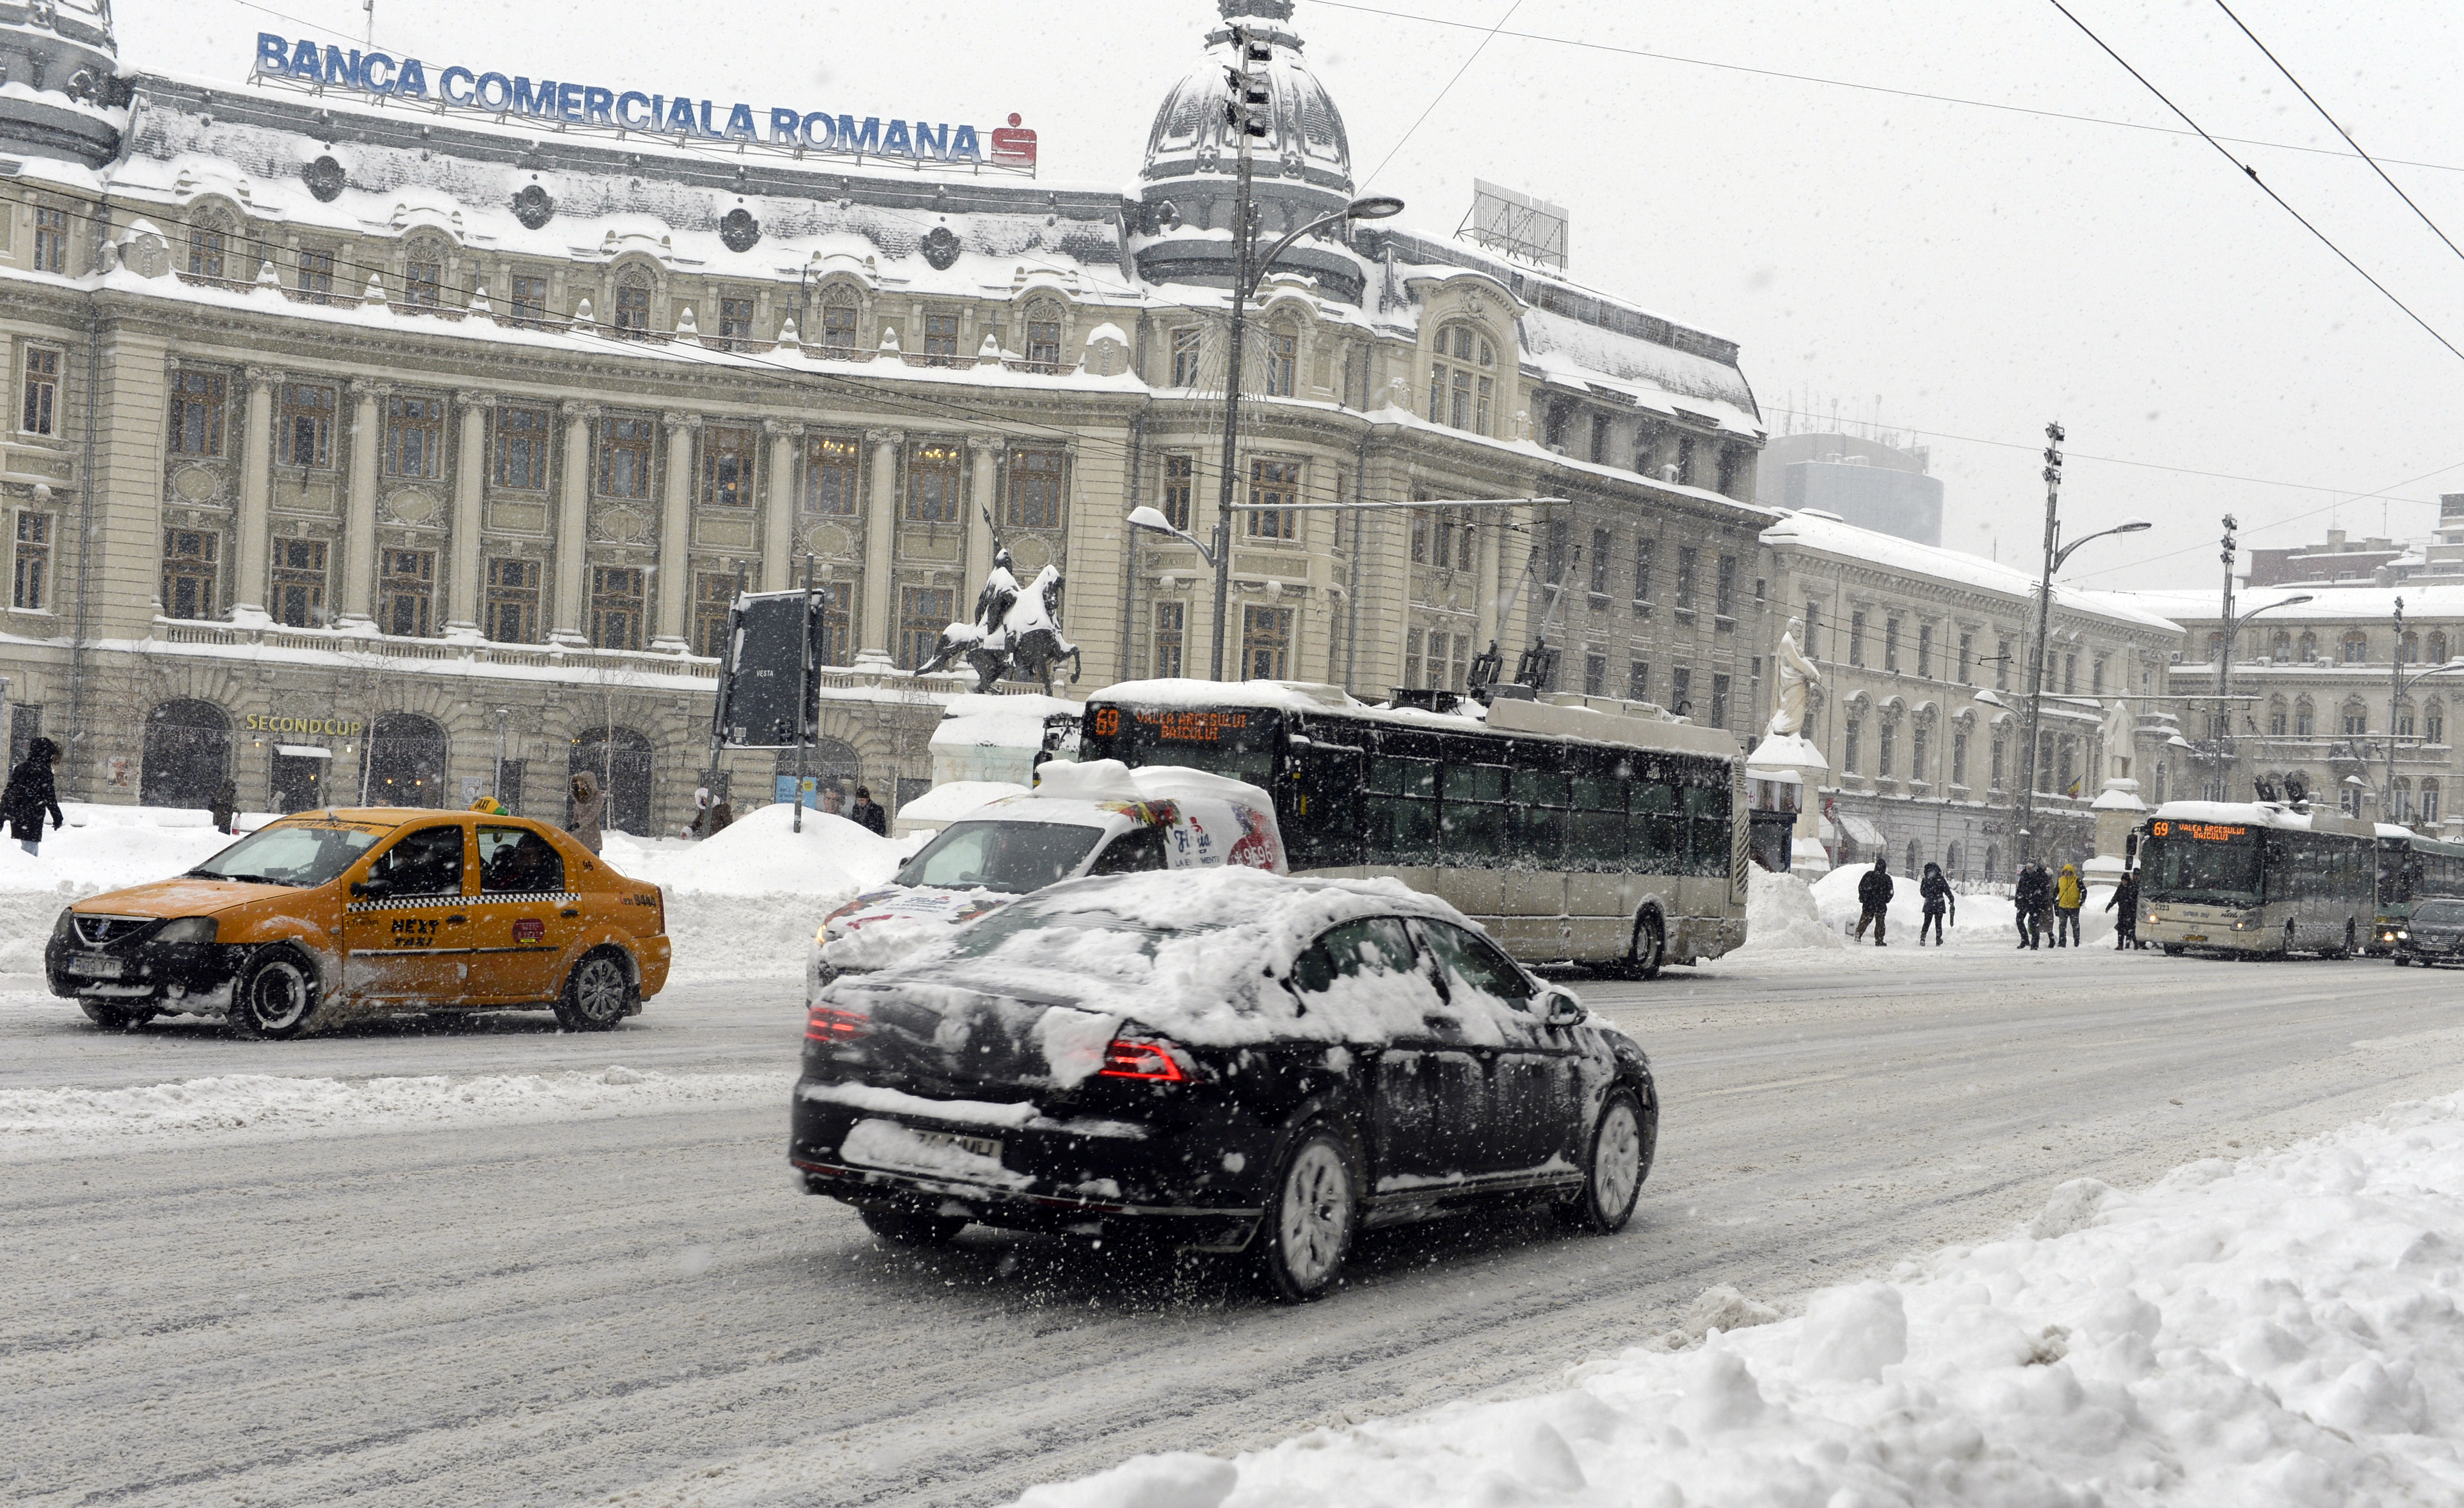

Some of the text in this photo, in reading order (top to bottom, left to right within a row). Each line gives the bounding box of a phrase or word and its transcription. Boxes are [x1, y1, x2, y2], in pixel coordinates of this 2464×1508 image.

[257, 32, 430, 101] BANCA
[439, 66, 758, 144] COMERCIALA
[769, 106, 982, 164] ROMANA
[246, 714, 363, 736] SECOND CUP
[1096, 709, 1119, 735] 69
[1161, 725, 1218, 740] BAICULUI
[475, 799, 490, 810] TAXI
[2154, 821, 2246, 836] 69 VALEA ARGESULUI
[2193, 831, 2229, 841] BAICULUI
[633, 893, 657, 908] 9444
[391, 919, 439, 935] NEXT
[395, 937, 433, 947] TAXI
[75, 959, 81, 971] B
